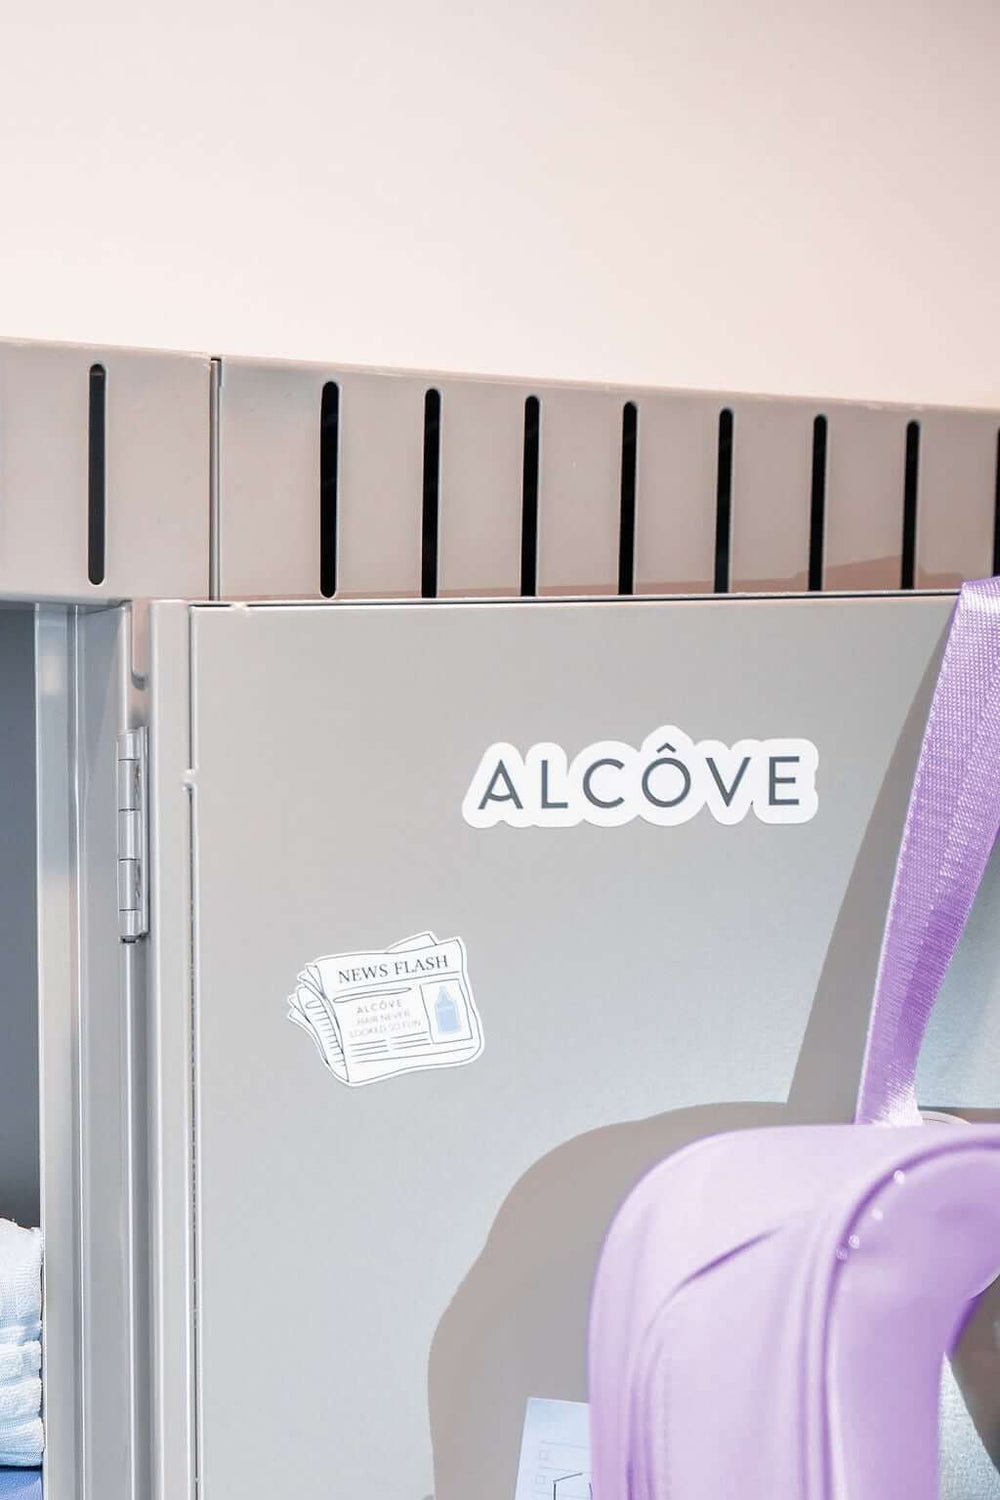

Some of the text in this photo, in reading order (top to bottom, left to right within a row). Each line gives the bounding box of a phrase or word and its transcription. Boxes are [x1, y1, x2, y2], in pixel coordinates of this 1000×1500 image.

[478, 742, 800, 809] ALCÔVE
[338, 955, 448, 984] NEWS FLASH
